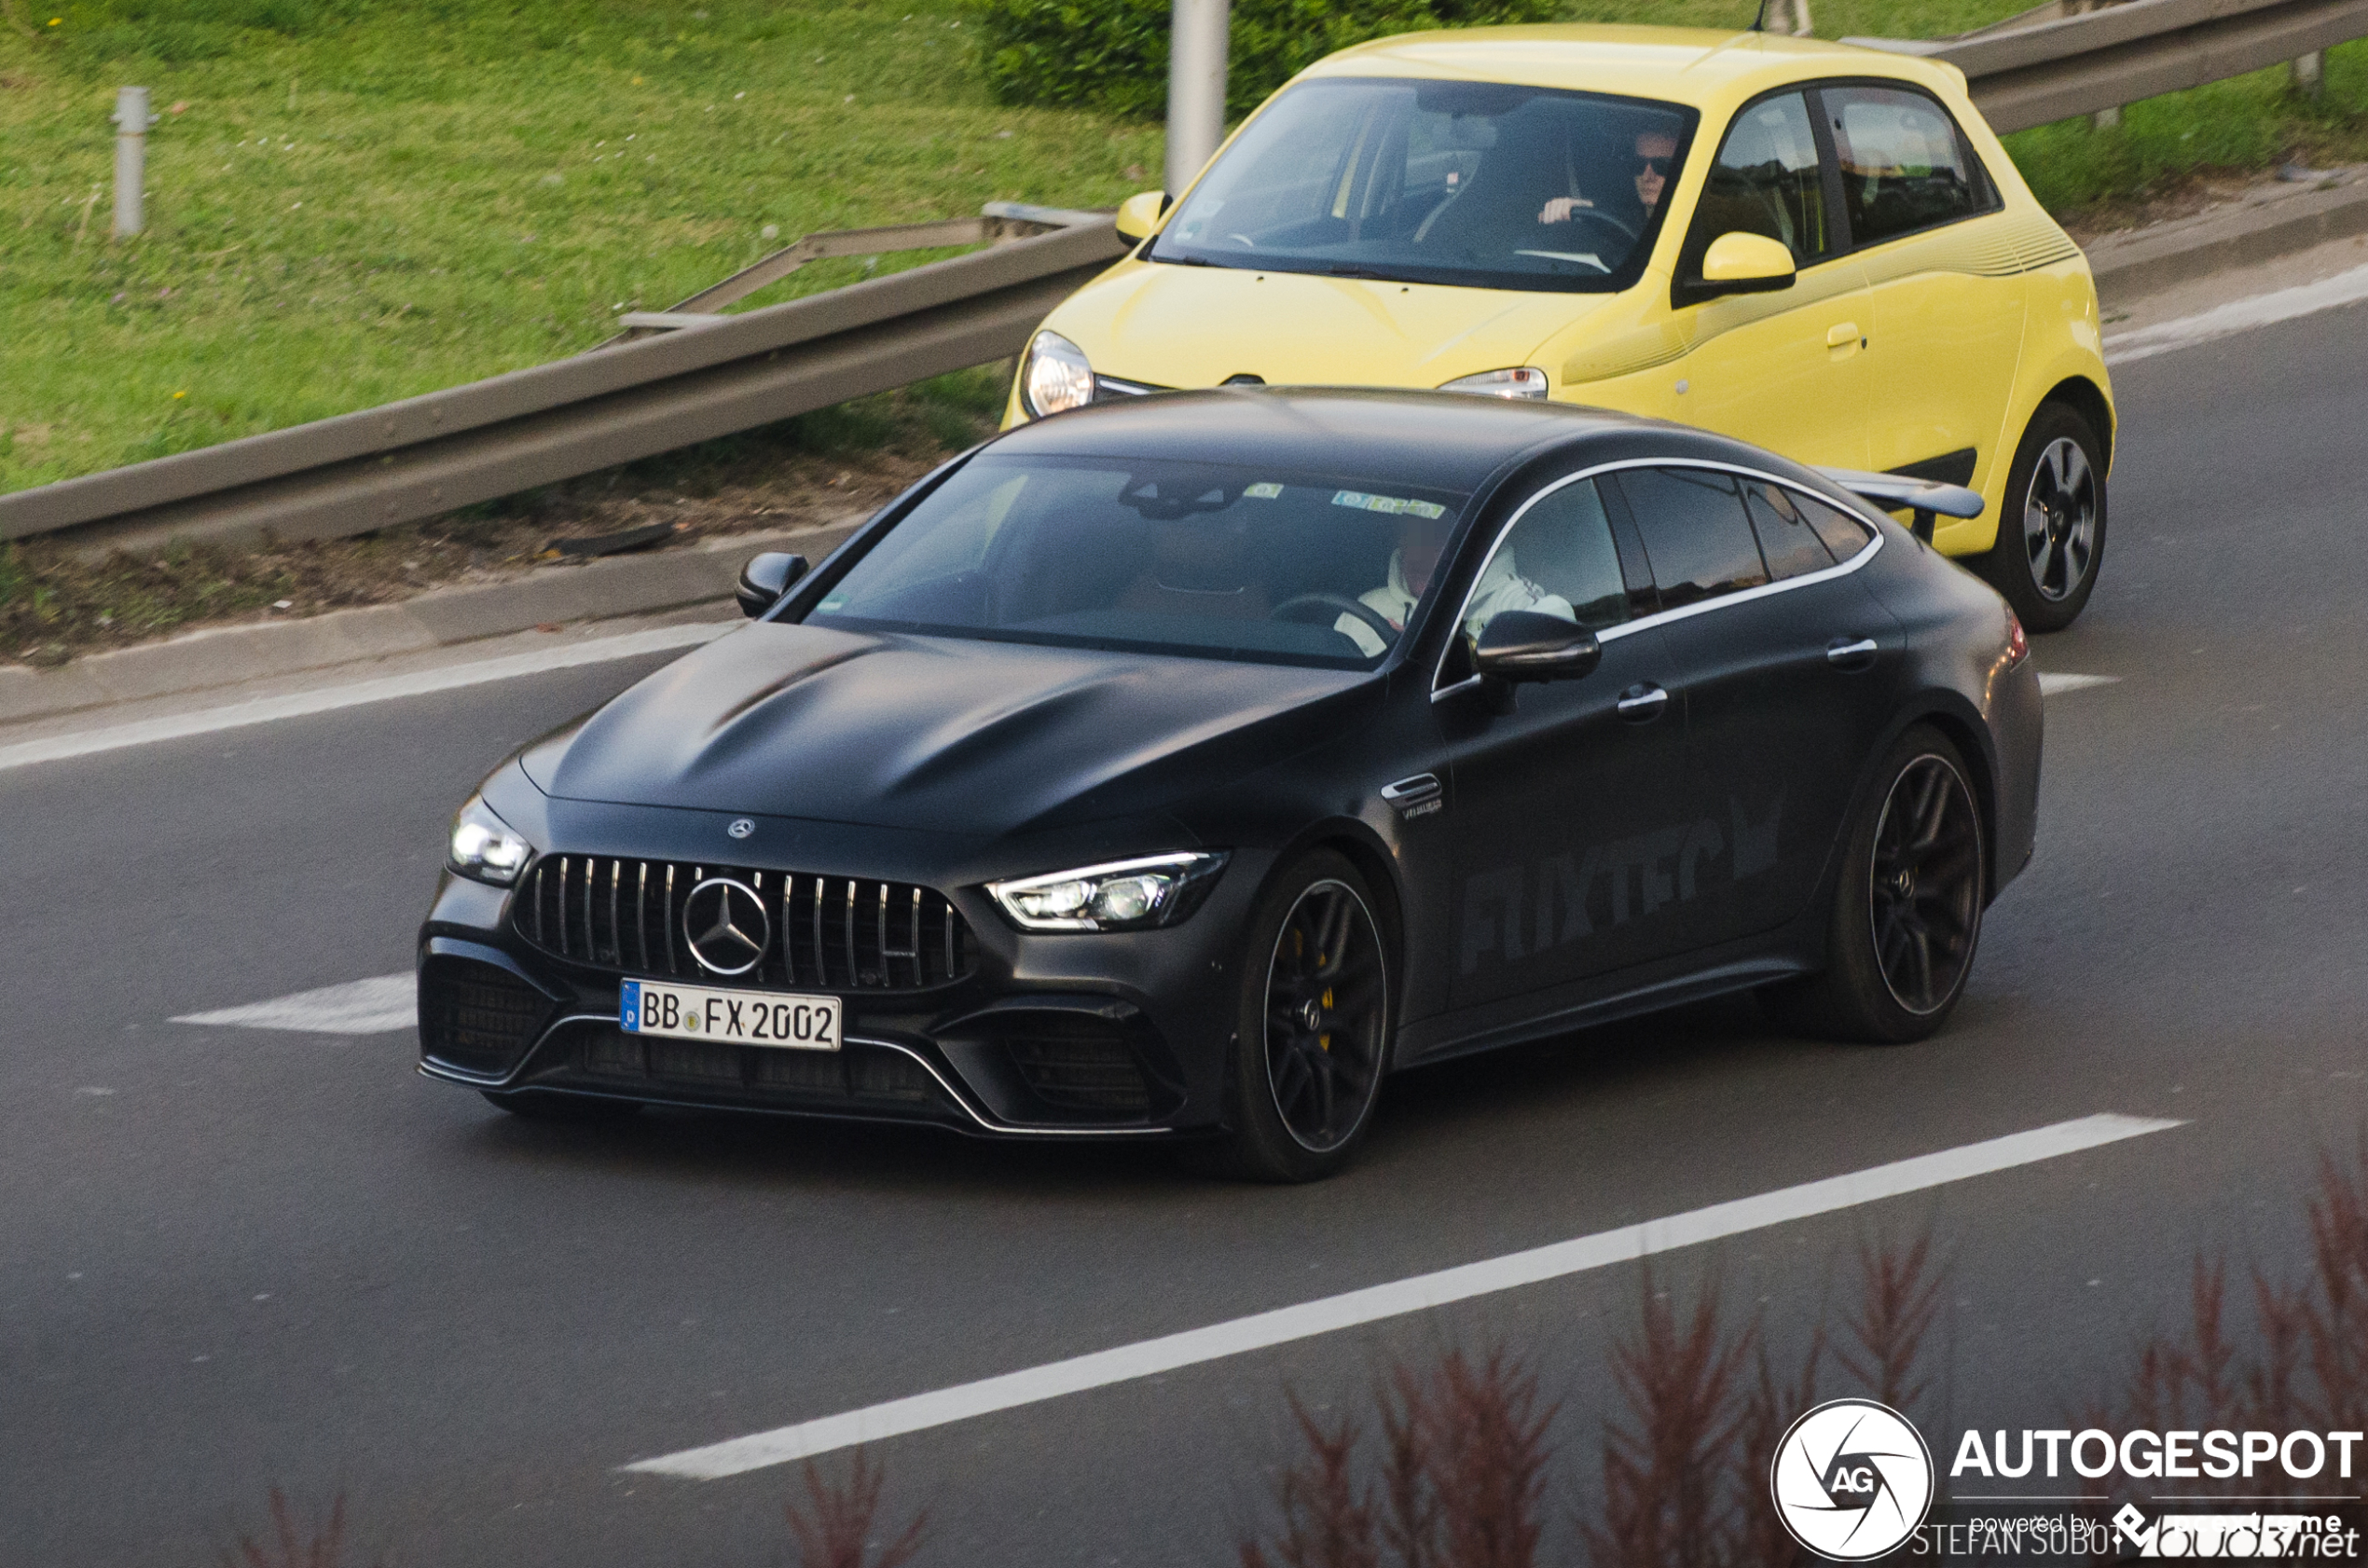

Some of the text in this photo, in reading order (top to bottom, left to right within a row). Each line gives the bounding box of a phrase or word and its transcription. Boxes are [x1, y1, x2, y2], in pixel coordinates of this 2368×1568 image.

[643, 992, 833, 1043] BB FX 2002
